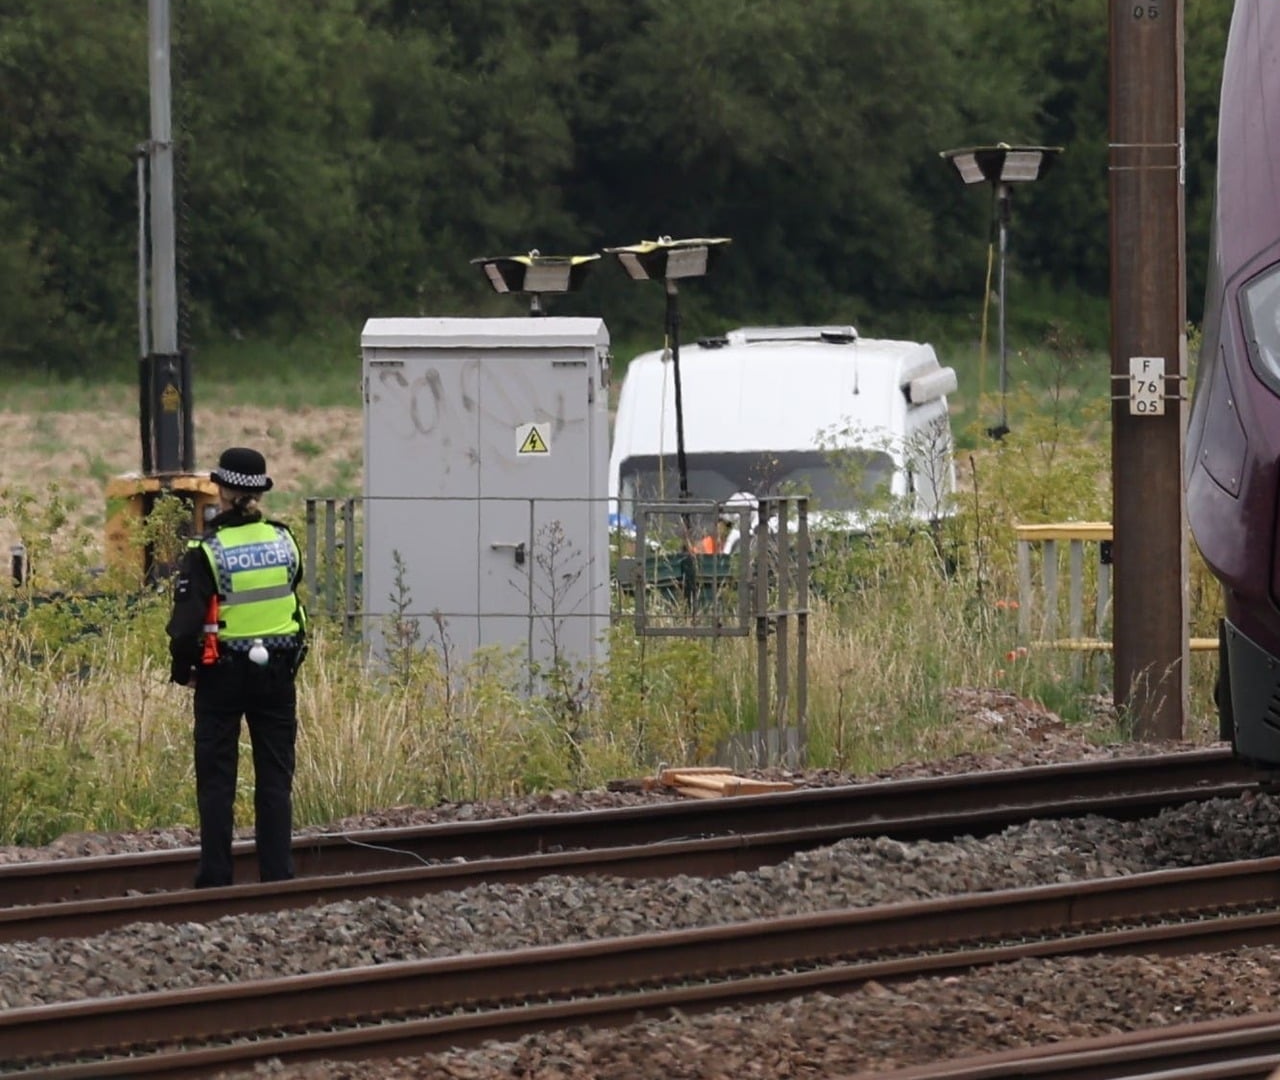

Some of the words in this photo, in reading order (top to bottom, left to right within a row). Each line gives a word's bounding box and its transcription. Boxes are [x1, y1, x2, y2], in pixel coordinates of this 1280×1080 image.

[1133, 5, 1158, 20] 05
[1143, 360, 1151, 372] F
[1137, 380, 1157, 393] 76
[1136, 400, 1157, 412] 05
[226, 549, 287, 570] POLICE
